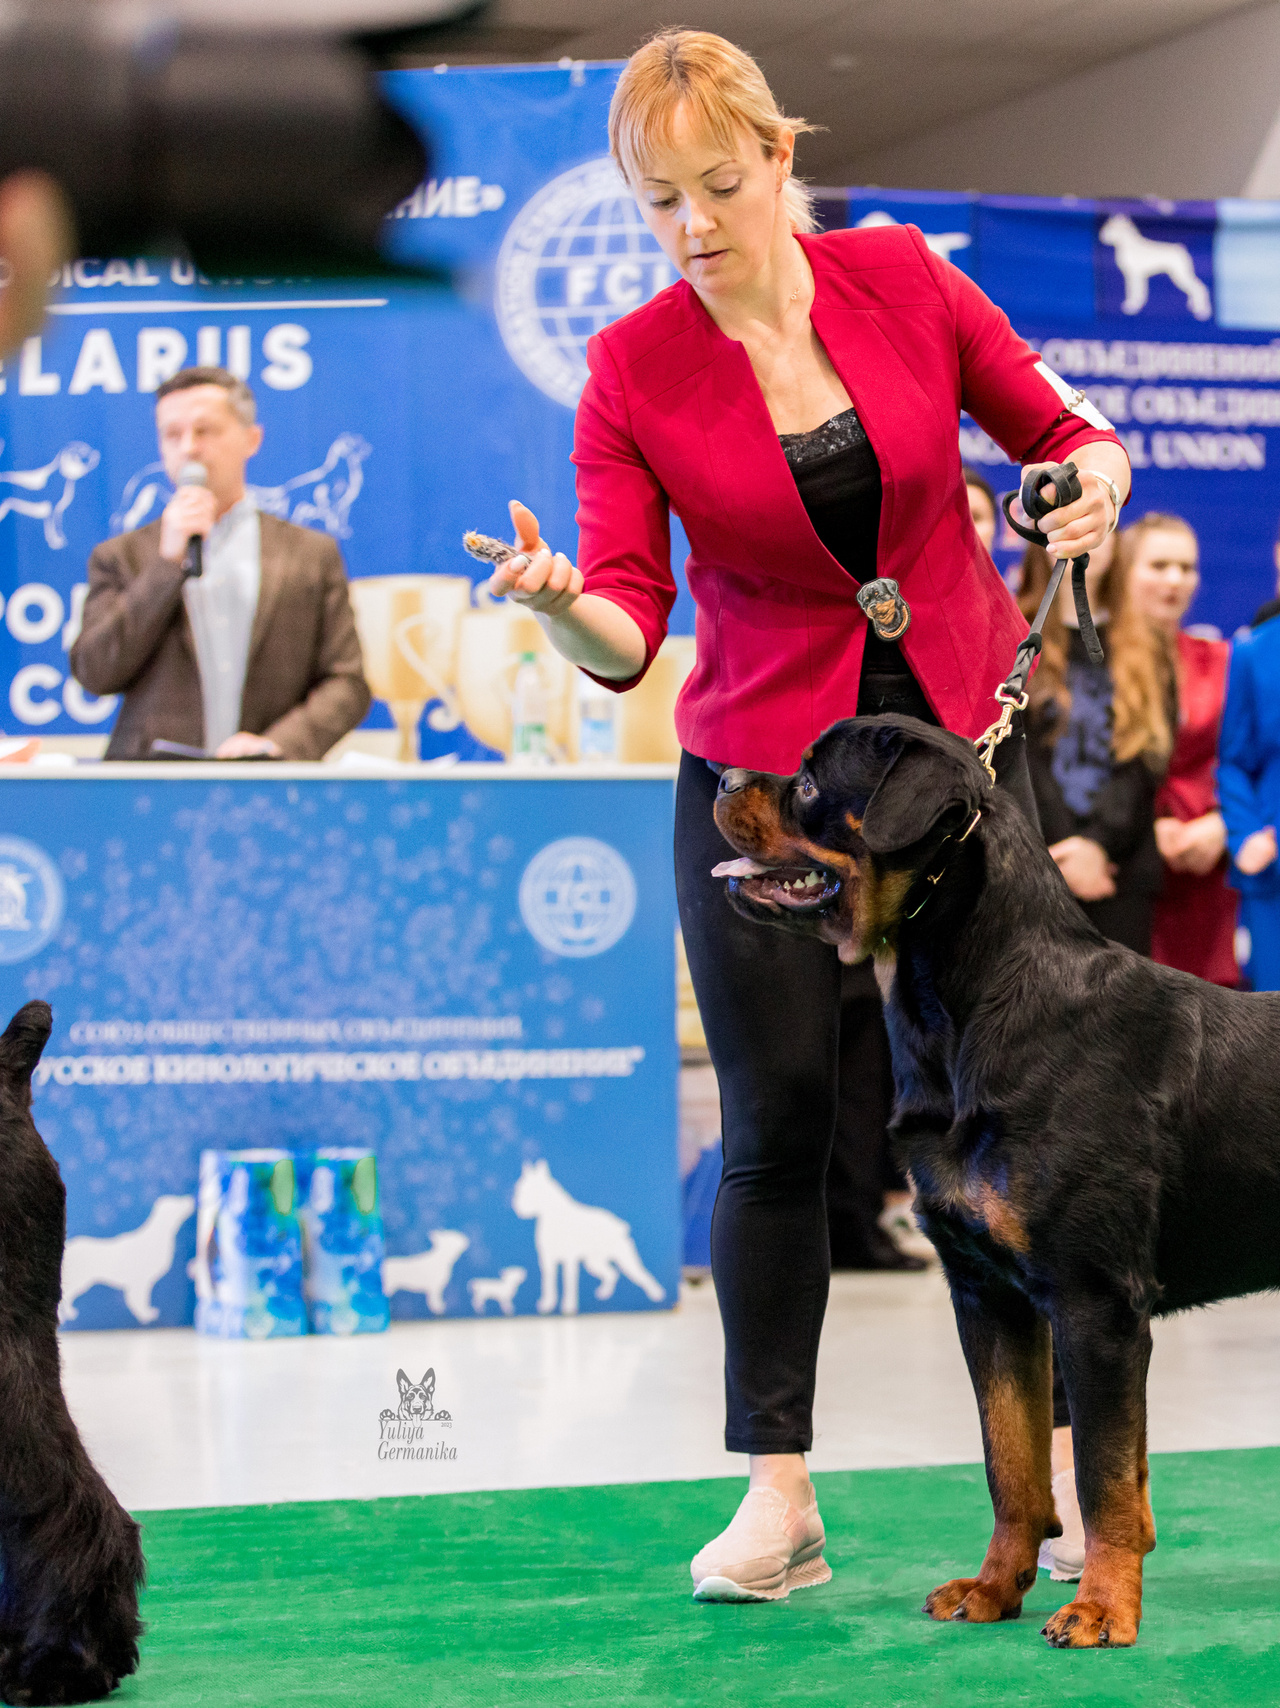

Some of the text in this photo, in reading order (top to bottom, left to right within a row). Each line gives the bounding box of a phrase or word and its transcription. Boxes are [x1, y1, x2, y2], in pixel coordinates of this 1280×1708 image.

[566, 260, 672, 307] FCI
[0, 323, 313, 397] LARUS
[1151, 432, 1267, 471] UNION
